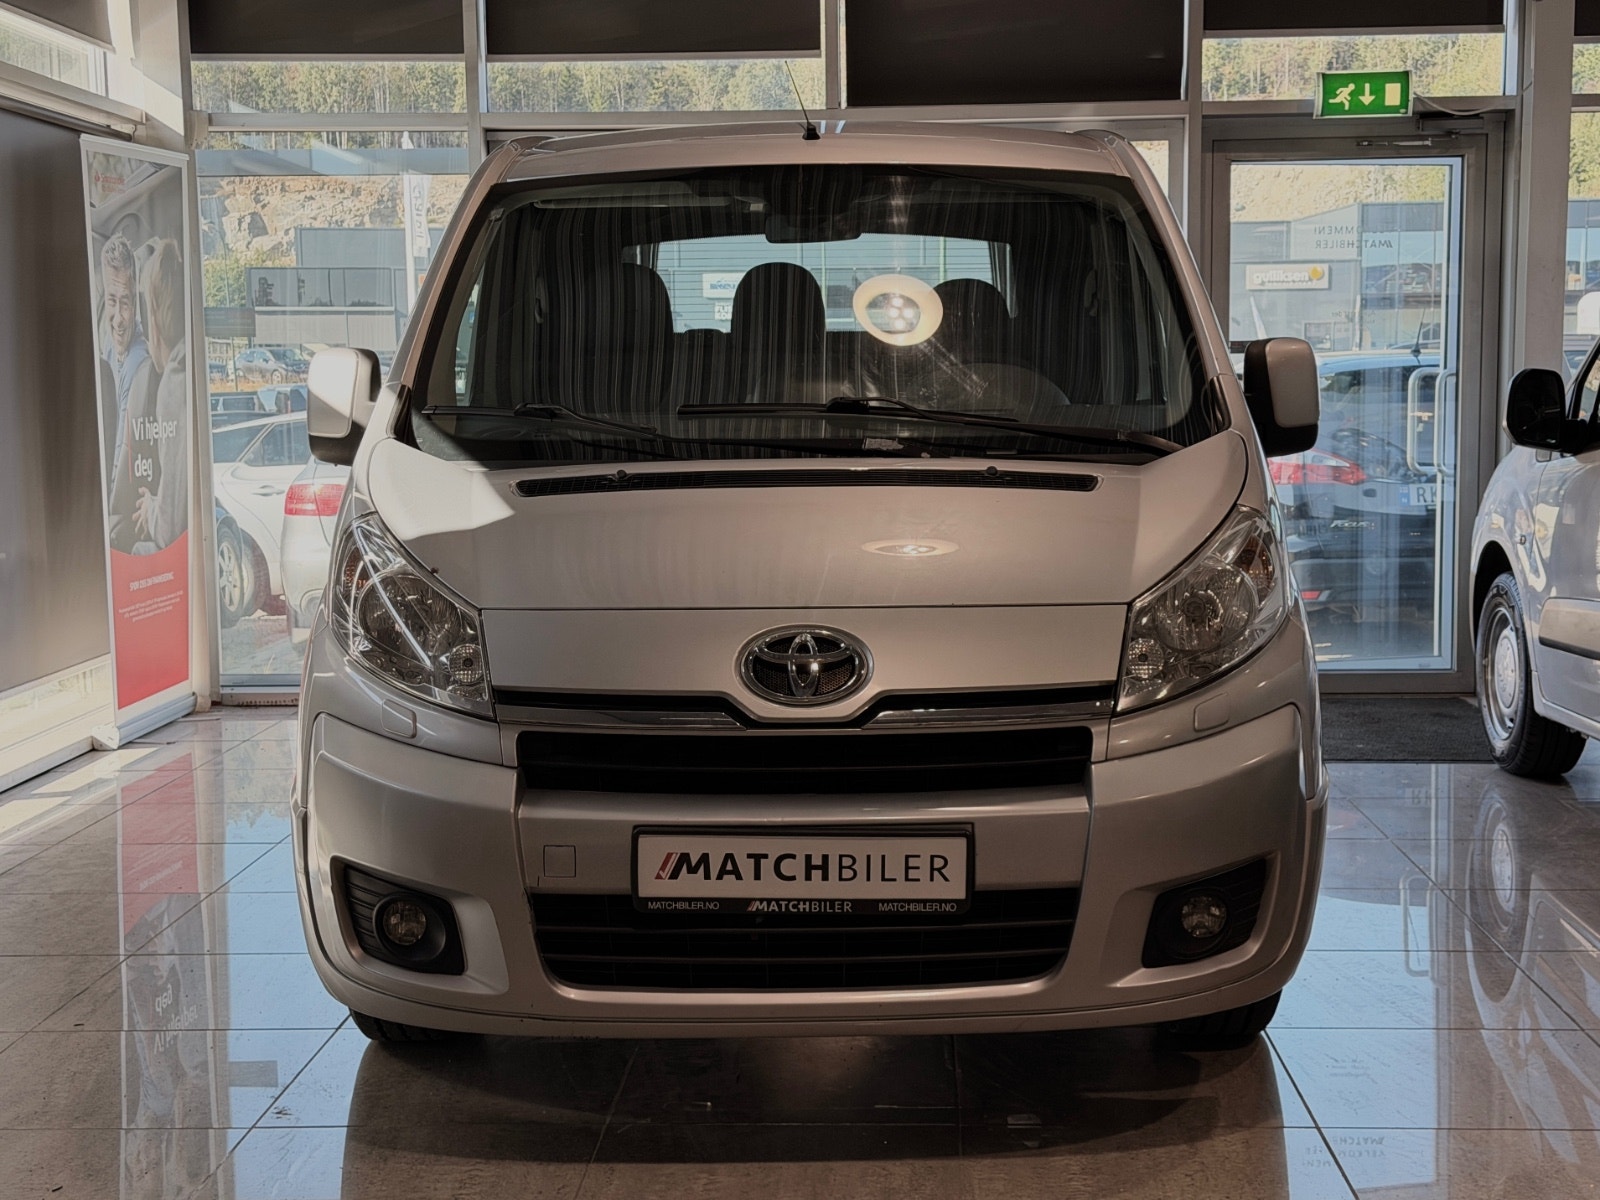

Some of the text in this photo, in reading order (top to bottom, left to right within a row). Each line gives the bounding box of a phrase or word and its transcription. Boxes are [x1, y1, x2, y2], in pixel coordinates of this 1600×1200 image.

[132, 416, 177, 446] Vi hjelper
[134, 453, 153, 482] deg
[666, 851, 951, 883] MATCHBILER
[647, 900, 957, 913] MATCHBILER.NO MATCHBILER MATCHBILER.NO
